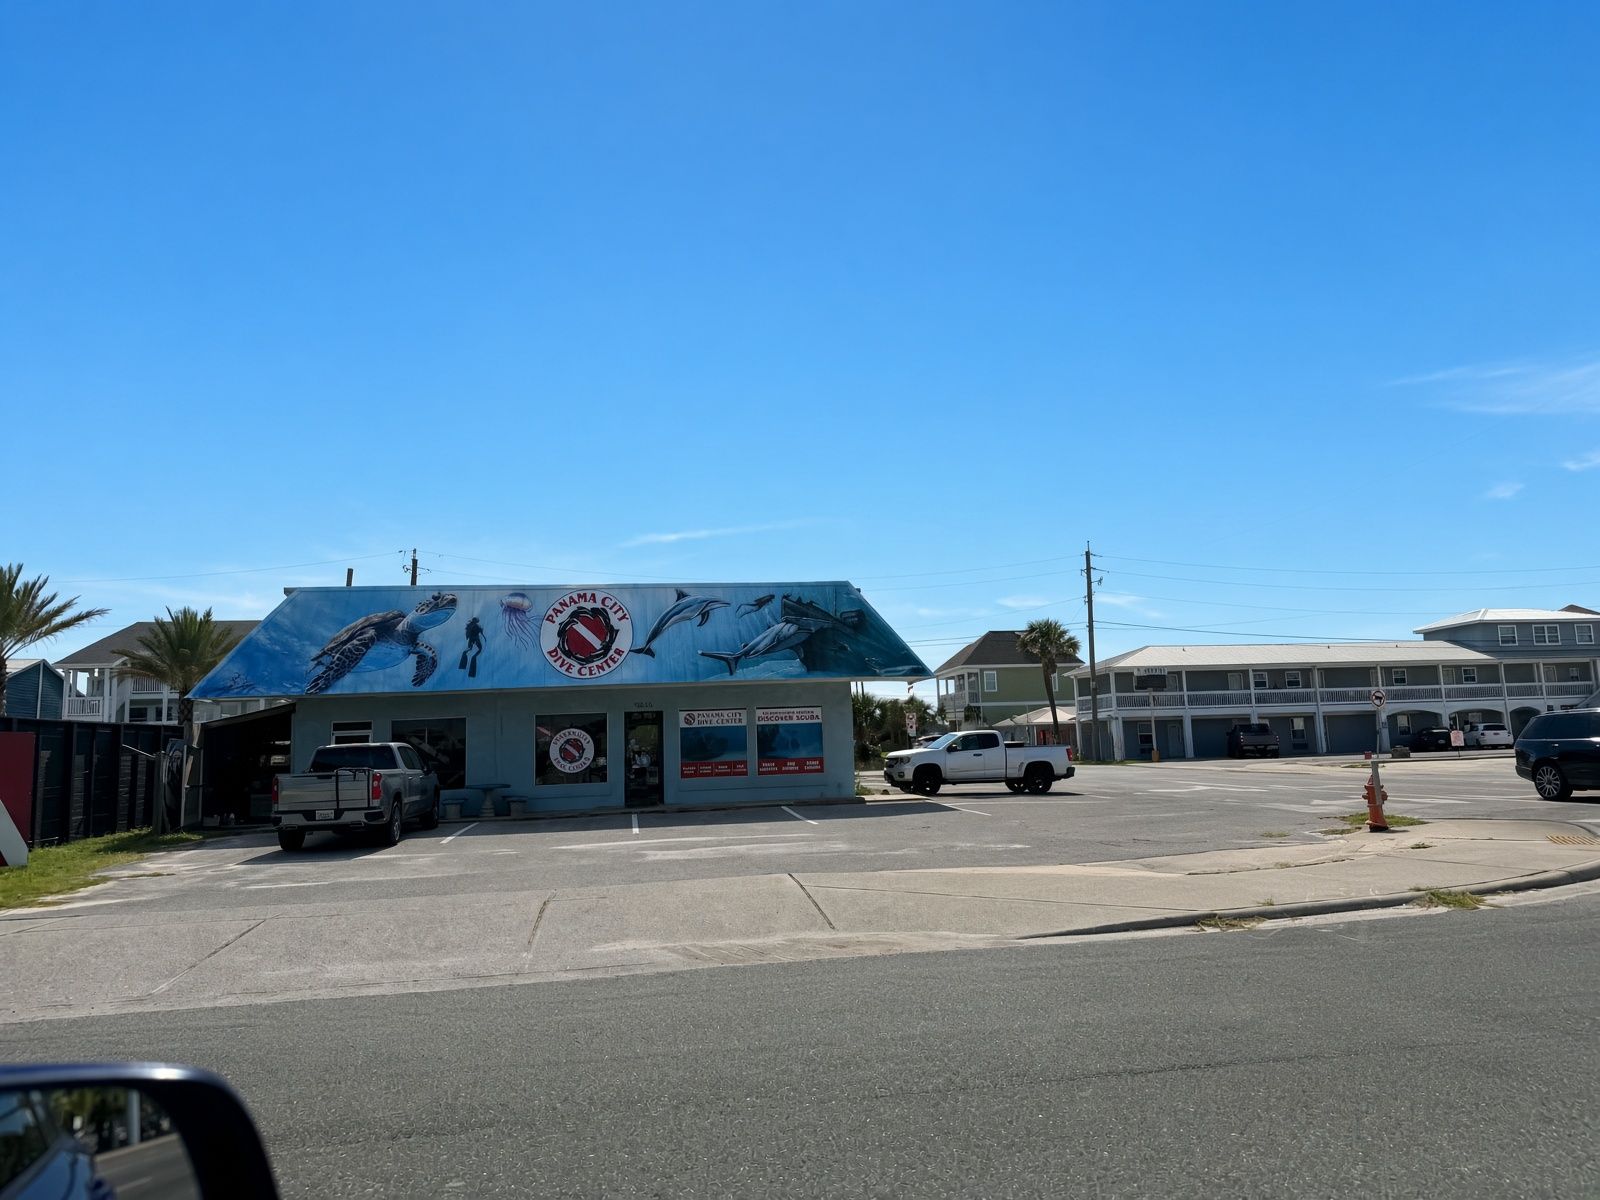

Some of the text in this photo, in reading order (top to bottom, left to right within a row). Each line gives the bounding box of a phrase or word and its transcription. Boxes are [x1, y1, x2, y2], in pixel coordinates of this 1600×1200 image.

[545, 593, 629, 624] PANAMA CITY
[547, 647, 625, 676] DIVE CENTER
[715, 717, 743, 725] CENTER
